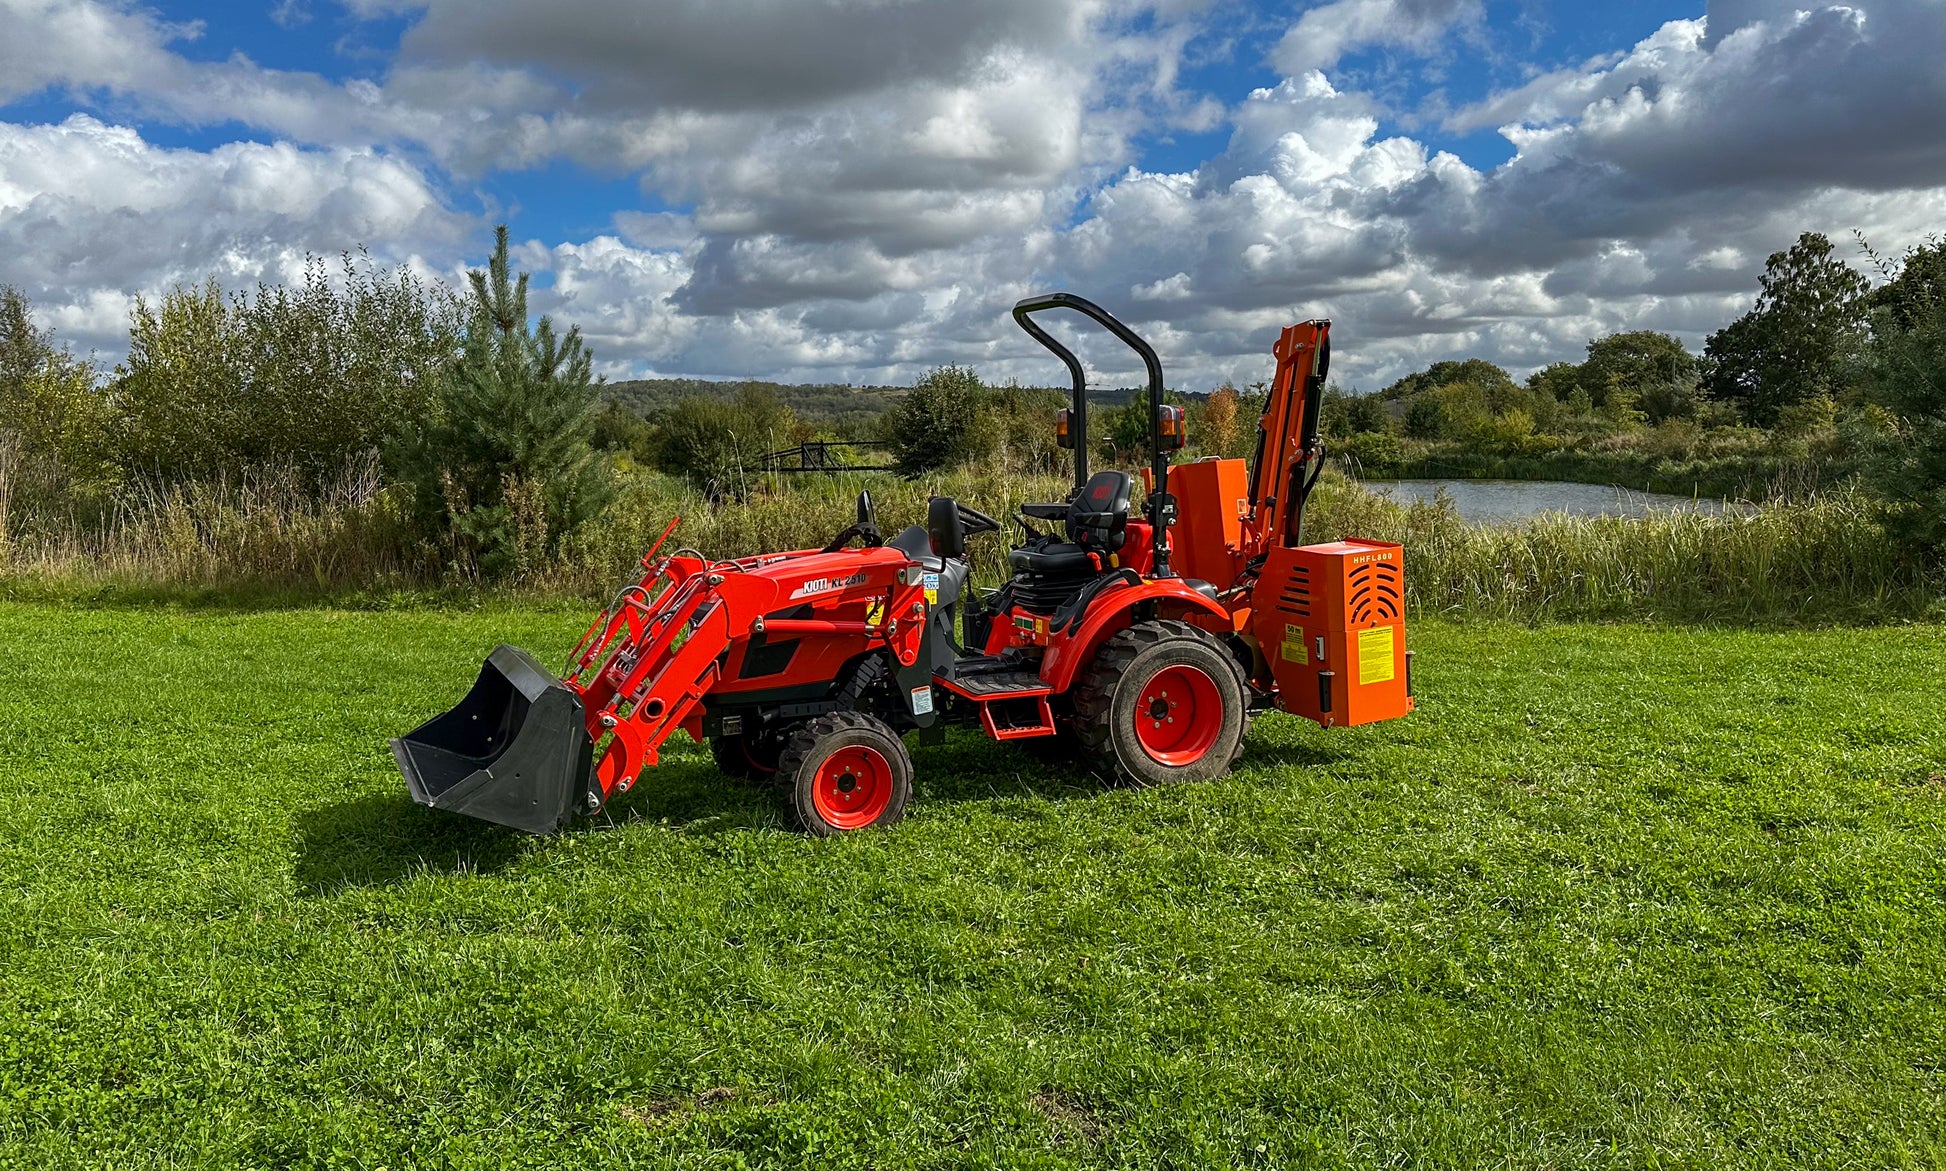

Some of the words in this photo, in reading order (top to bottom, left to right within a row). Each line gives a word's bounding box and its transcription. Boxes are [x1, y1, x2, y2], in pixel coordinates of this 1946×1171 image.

[1353, 553, 1393, 564] HHFL800
[803, 578, 828, 594] KIOTI
[831, 577, 843, 588] KL
[845, 573, 866, 586] 2510
